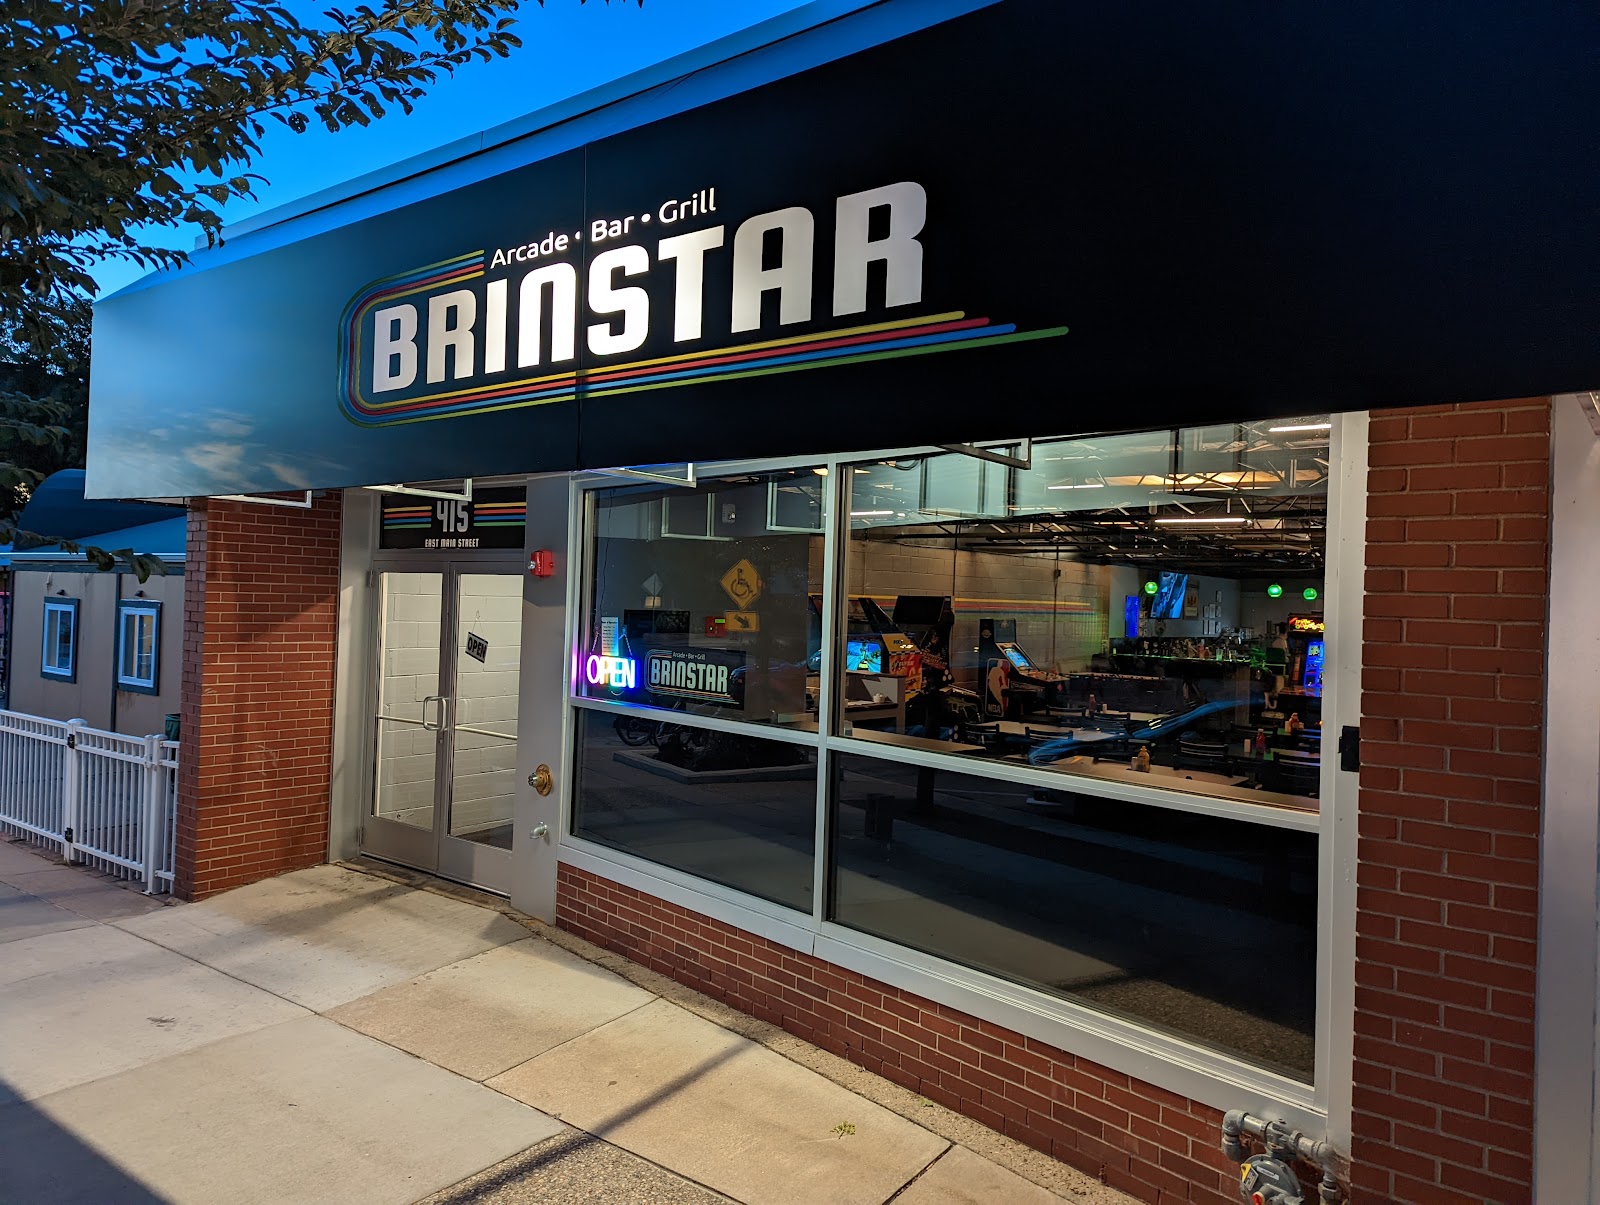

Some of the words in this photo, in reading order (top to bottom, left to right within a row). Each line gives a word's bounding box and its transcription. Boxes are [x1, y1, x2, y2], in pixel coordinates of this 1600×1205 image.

[490, 231, 568, 269] Arcade
[592, 215, 634, 242] Bar
[659, 191, 716, 223] Grill
[373, 181, 927, 393] BRINSTAR
[436, 500, 469, 532] 415
[425, 539, 439, 547] EAST
[440, 539, 456, 547] MAIN
[458, 538, 479, 547] STREET
[467, 637, 487, 660] OPEN
[586, 655, 636, 688] OPEN
[650, 659, 728, 692] BRINSTAR
[988, 704, 1001, 713] NBA
